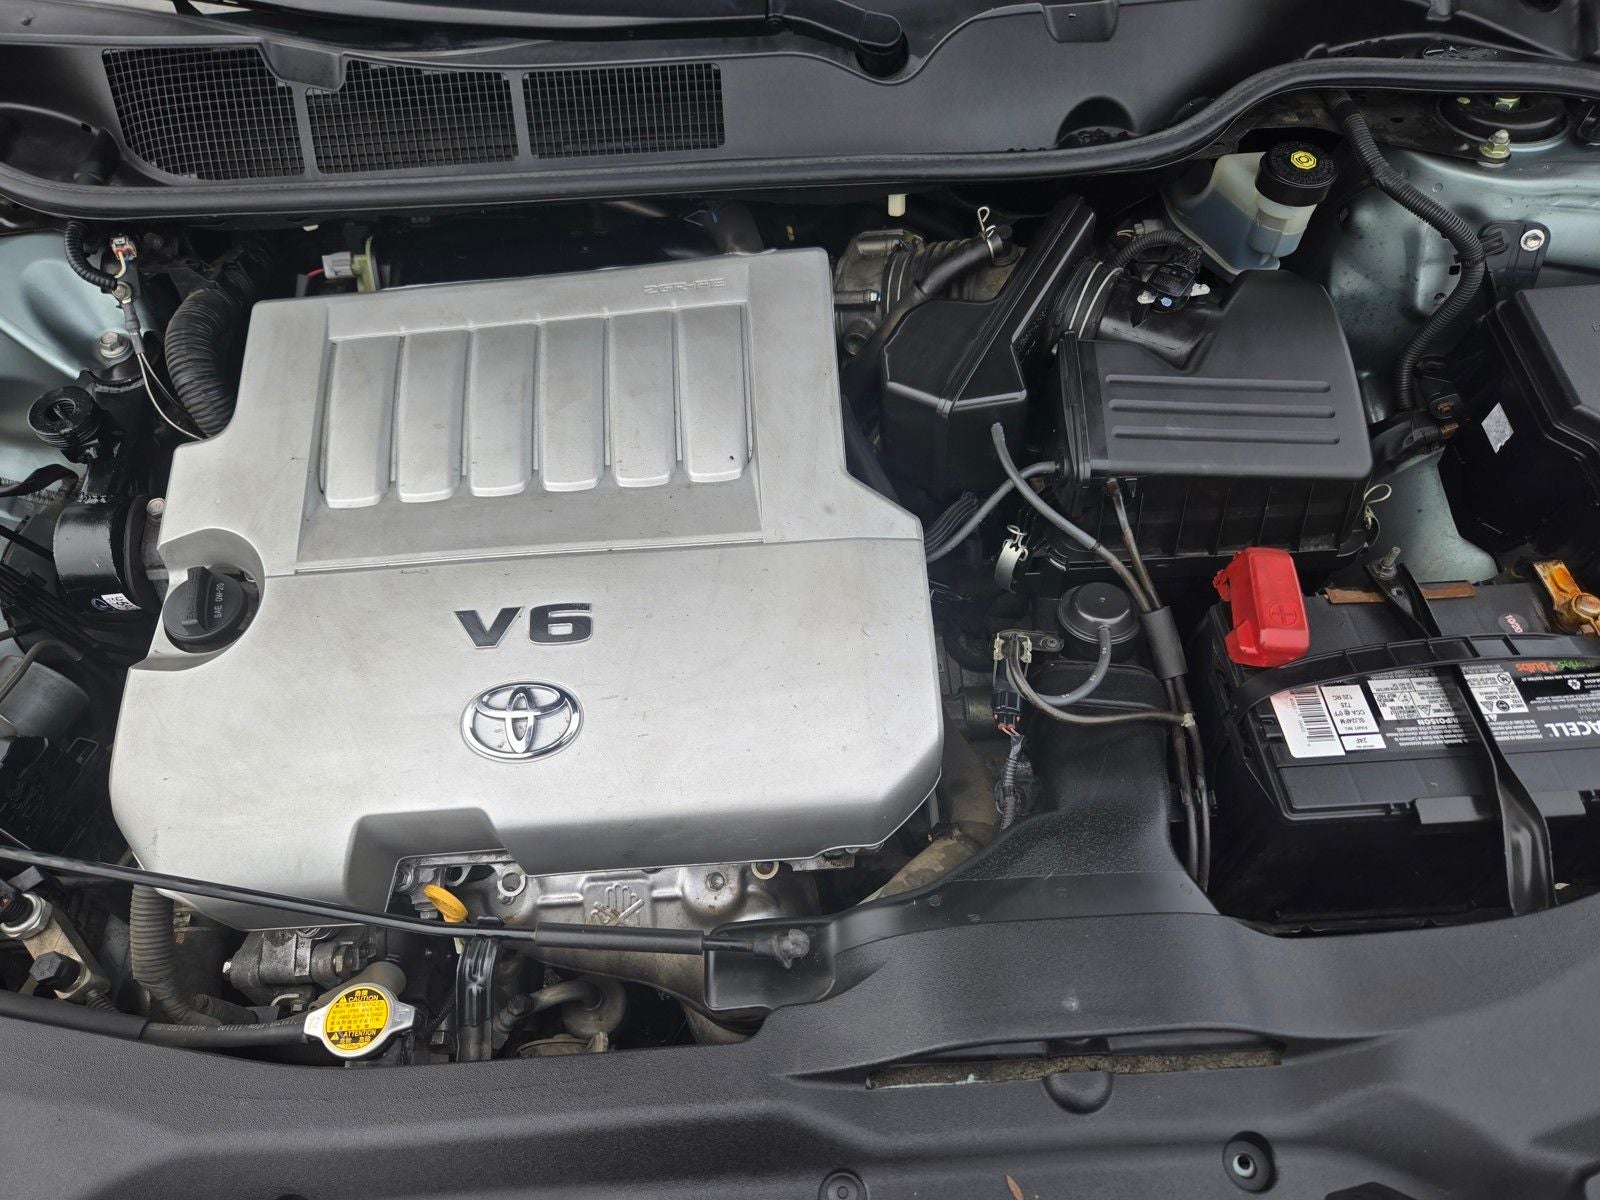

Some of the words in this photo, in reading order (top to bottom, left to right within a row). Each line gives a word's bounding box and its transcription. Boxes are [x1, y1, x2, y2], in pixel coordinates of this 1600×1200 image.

[213, 604, 223, 619] SAE
[453, 602, 594, 650] V6
[343, 1029, 377, 1037] ATTENTION
